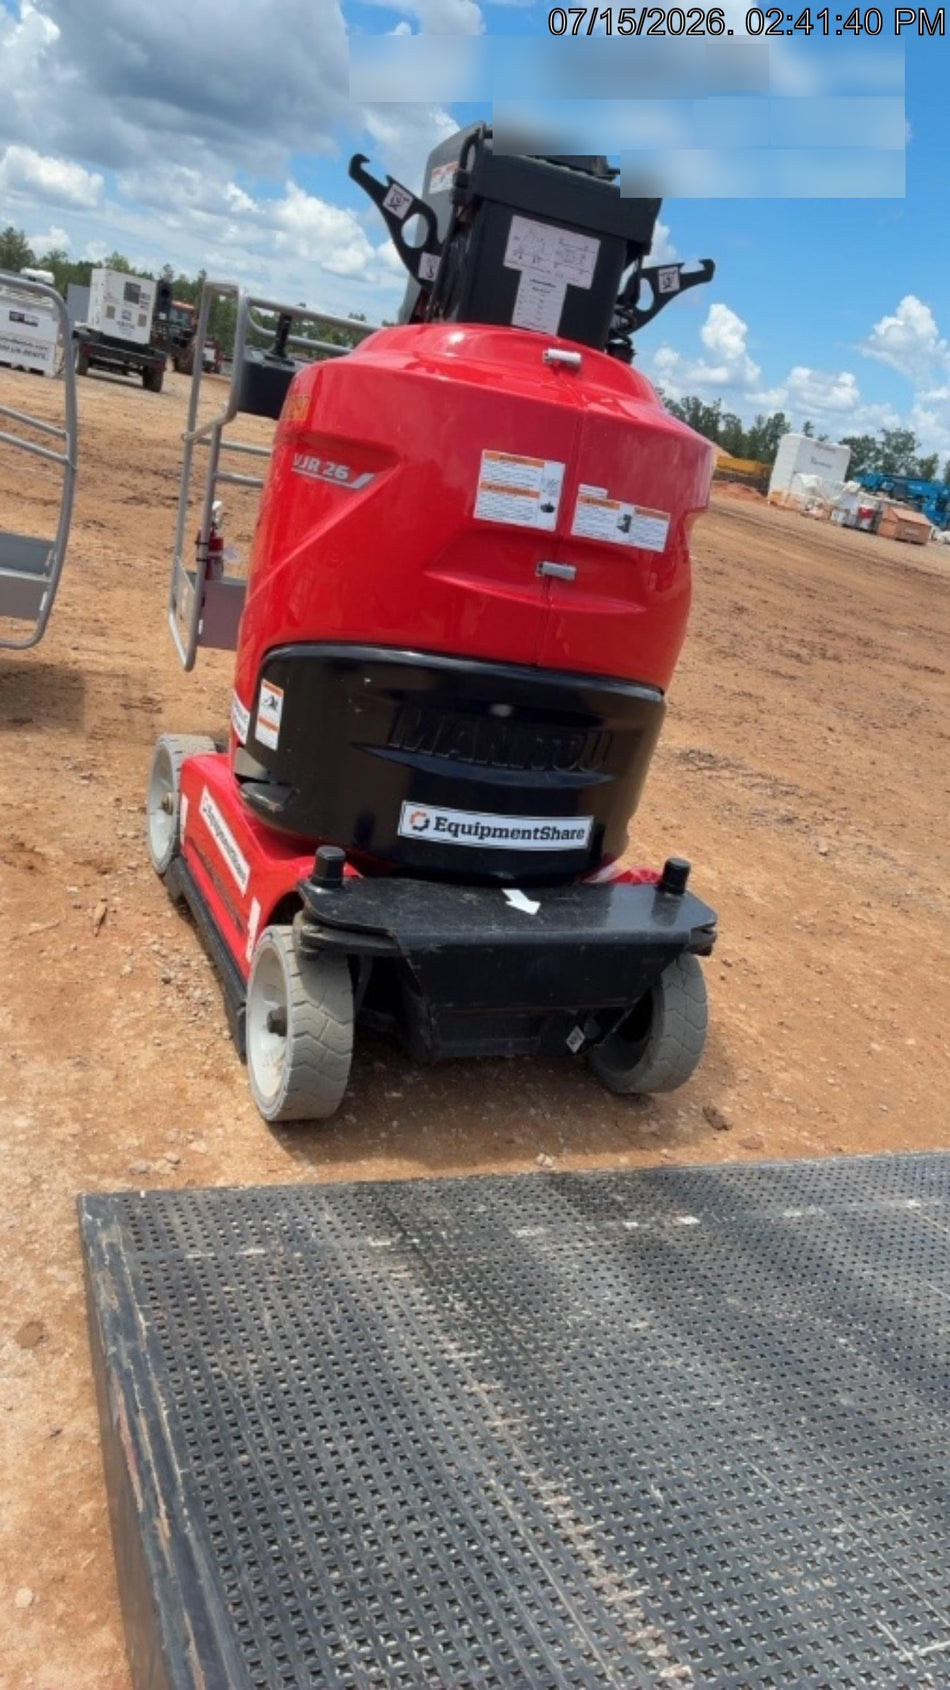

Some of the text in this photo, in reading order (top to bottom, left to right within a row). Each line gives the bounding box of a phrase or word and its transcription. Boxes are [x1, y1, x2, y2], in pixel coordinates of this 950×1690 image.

[292, 453, 350, 481] VJR 26
[434, 816, 585, 841] EquipmentShare
